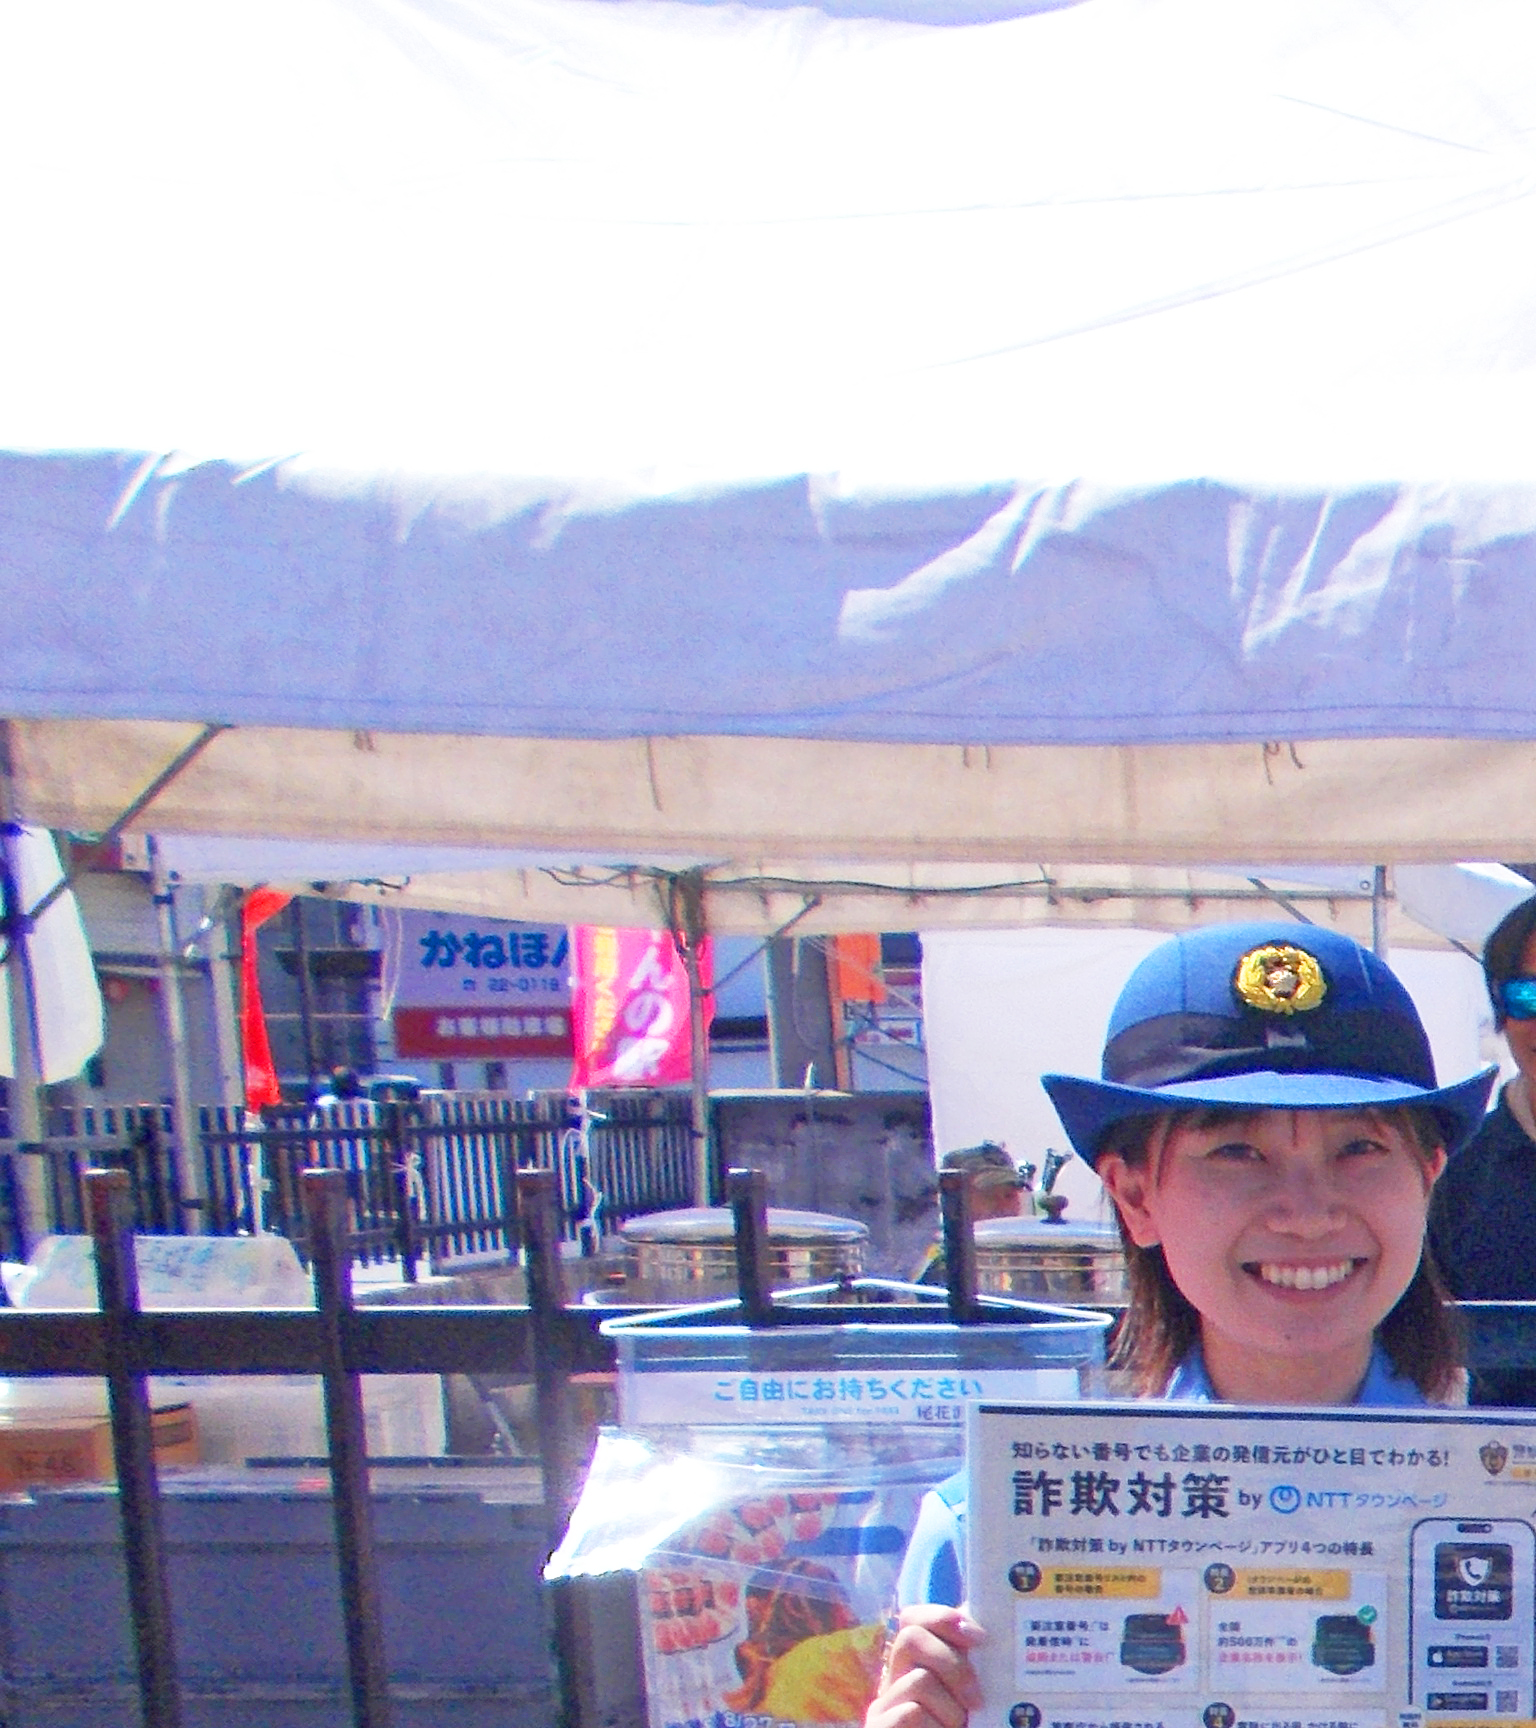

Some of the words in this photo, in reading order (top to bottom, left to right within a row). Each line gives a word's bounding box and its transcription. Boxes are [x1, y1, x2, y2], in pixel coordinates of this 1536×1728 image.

[714, 1376, 984, 1401] ご自由にお持ちください
[1012, 1470, 1230, 1518] 詐欺対策
[1238, 1490, 1263, 1510] by
[1306, 1491, 1448, 1509] NTTタウンページ
